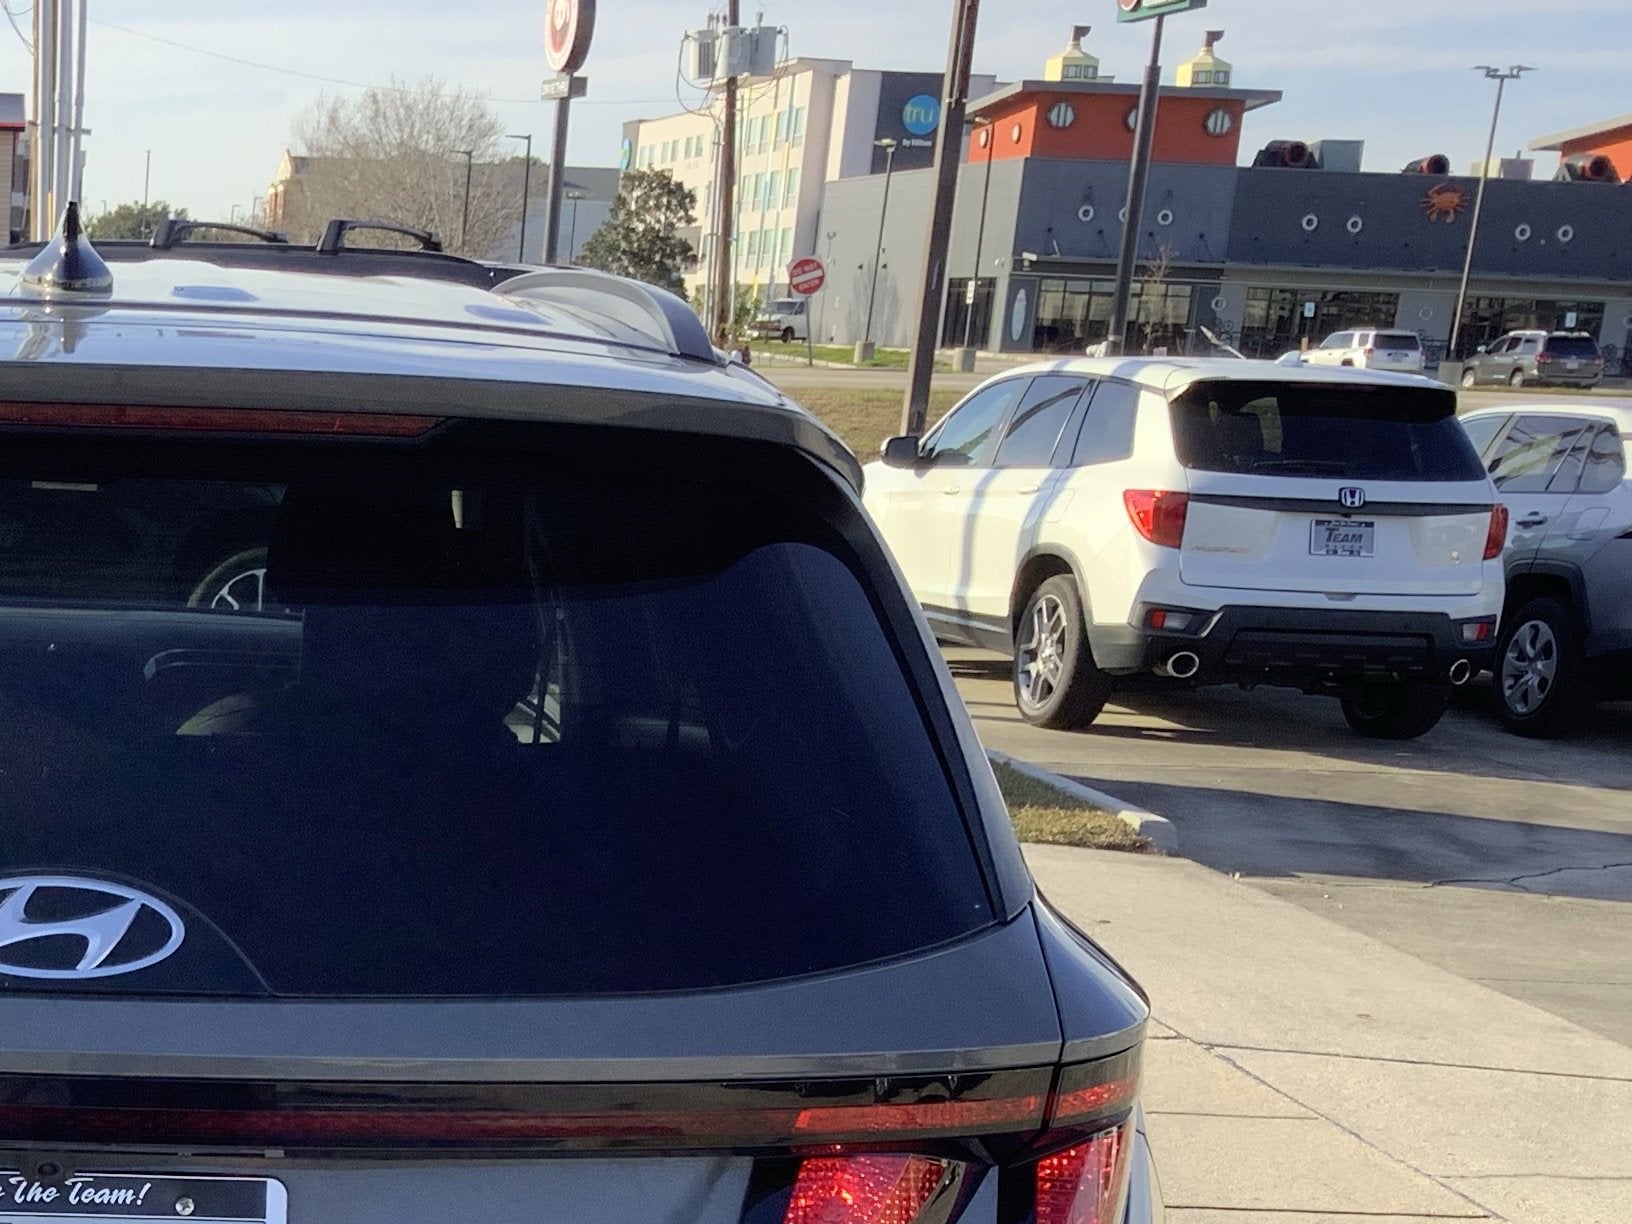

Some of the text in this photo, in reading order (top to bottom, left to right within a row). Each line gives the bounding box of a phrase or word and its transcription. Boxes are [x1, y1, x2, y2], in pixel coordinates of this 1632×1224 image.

[904, 103, 934, 123] tru
[1325, 527, 1363, 543] TEAM
[9, 1176, 60, 1204] The
[64, 1177, 152, 1206] Team!
